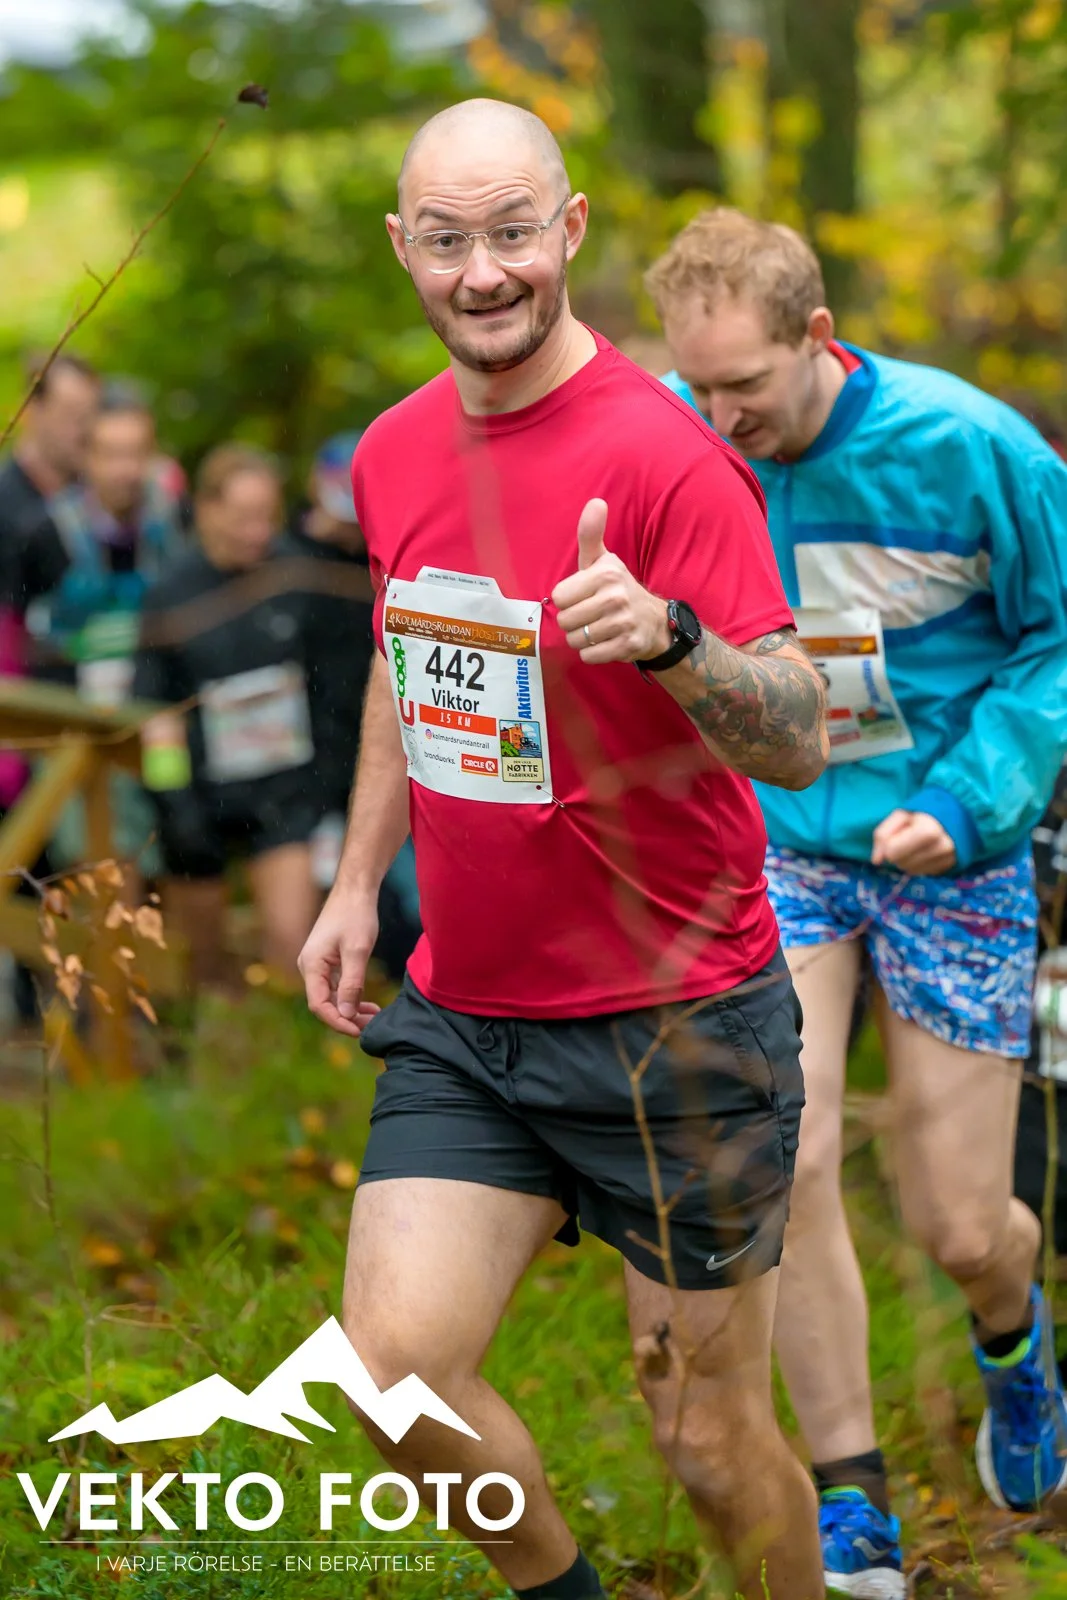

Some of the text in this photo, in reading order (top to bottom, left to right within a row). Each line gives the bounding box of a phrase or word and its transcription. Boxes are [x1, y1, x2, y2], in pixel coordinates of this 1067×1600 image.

[392, 636, 405, 697] coop
[425, 645, 485, 692] 442
[516, 658, 532, 720] Aktivitus
[431, 687, 480, 713] Viktor
[440, 712, 471, 728] 15 KM
[432, 732, 490, 749] kolmardsrundantrail
[463, 758, 485, 769] CIRCLE
[506, 764, 539, 773] NØTTE
